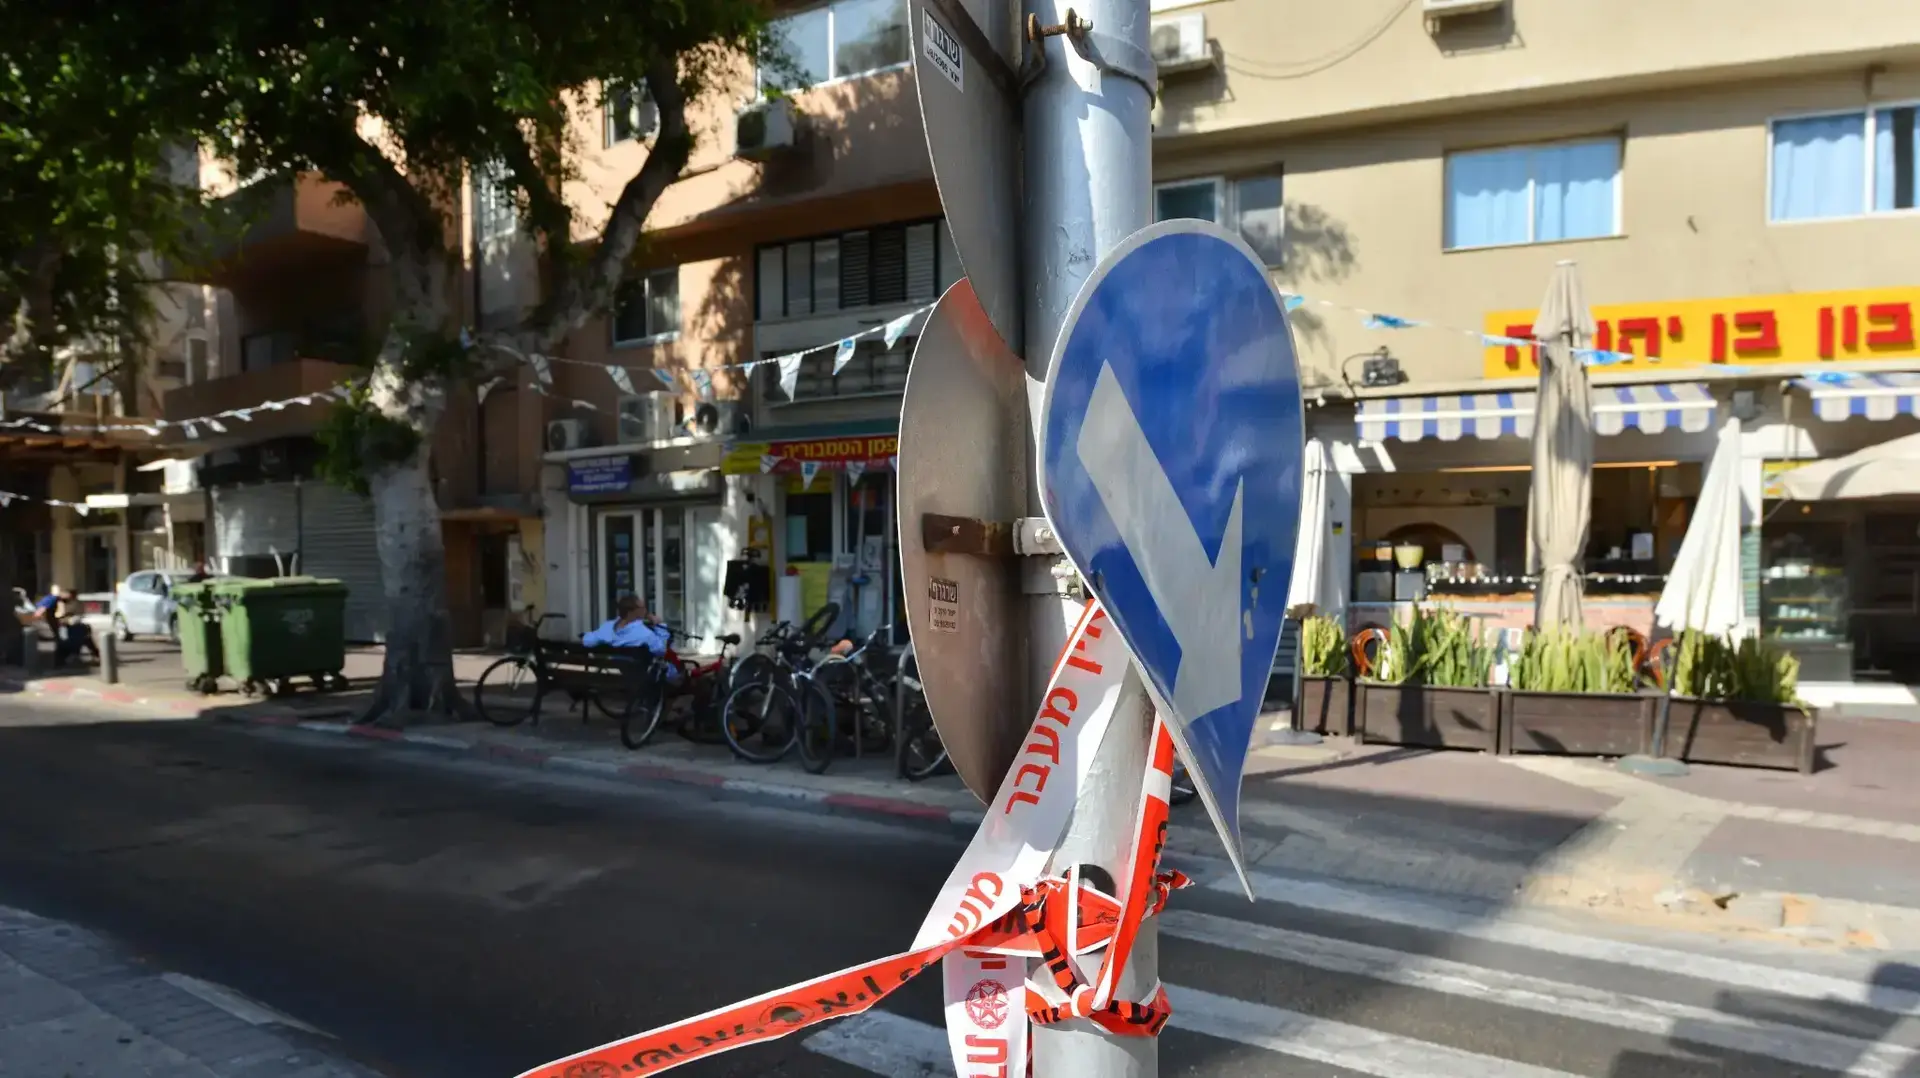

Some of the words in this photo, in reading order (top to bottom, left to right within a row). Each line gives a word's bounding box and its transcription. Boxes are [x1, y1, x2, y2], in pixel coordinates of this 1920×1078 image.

[1505, 316, 1683, 370] יהוה
[1711, 310, 1780, 364] בן
[1005, 686, 1077, 814] מעבר
